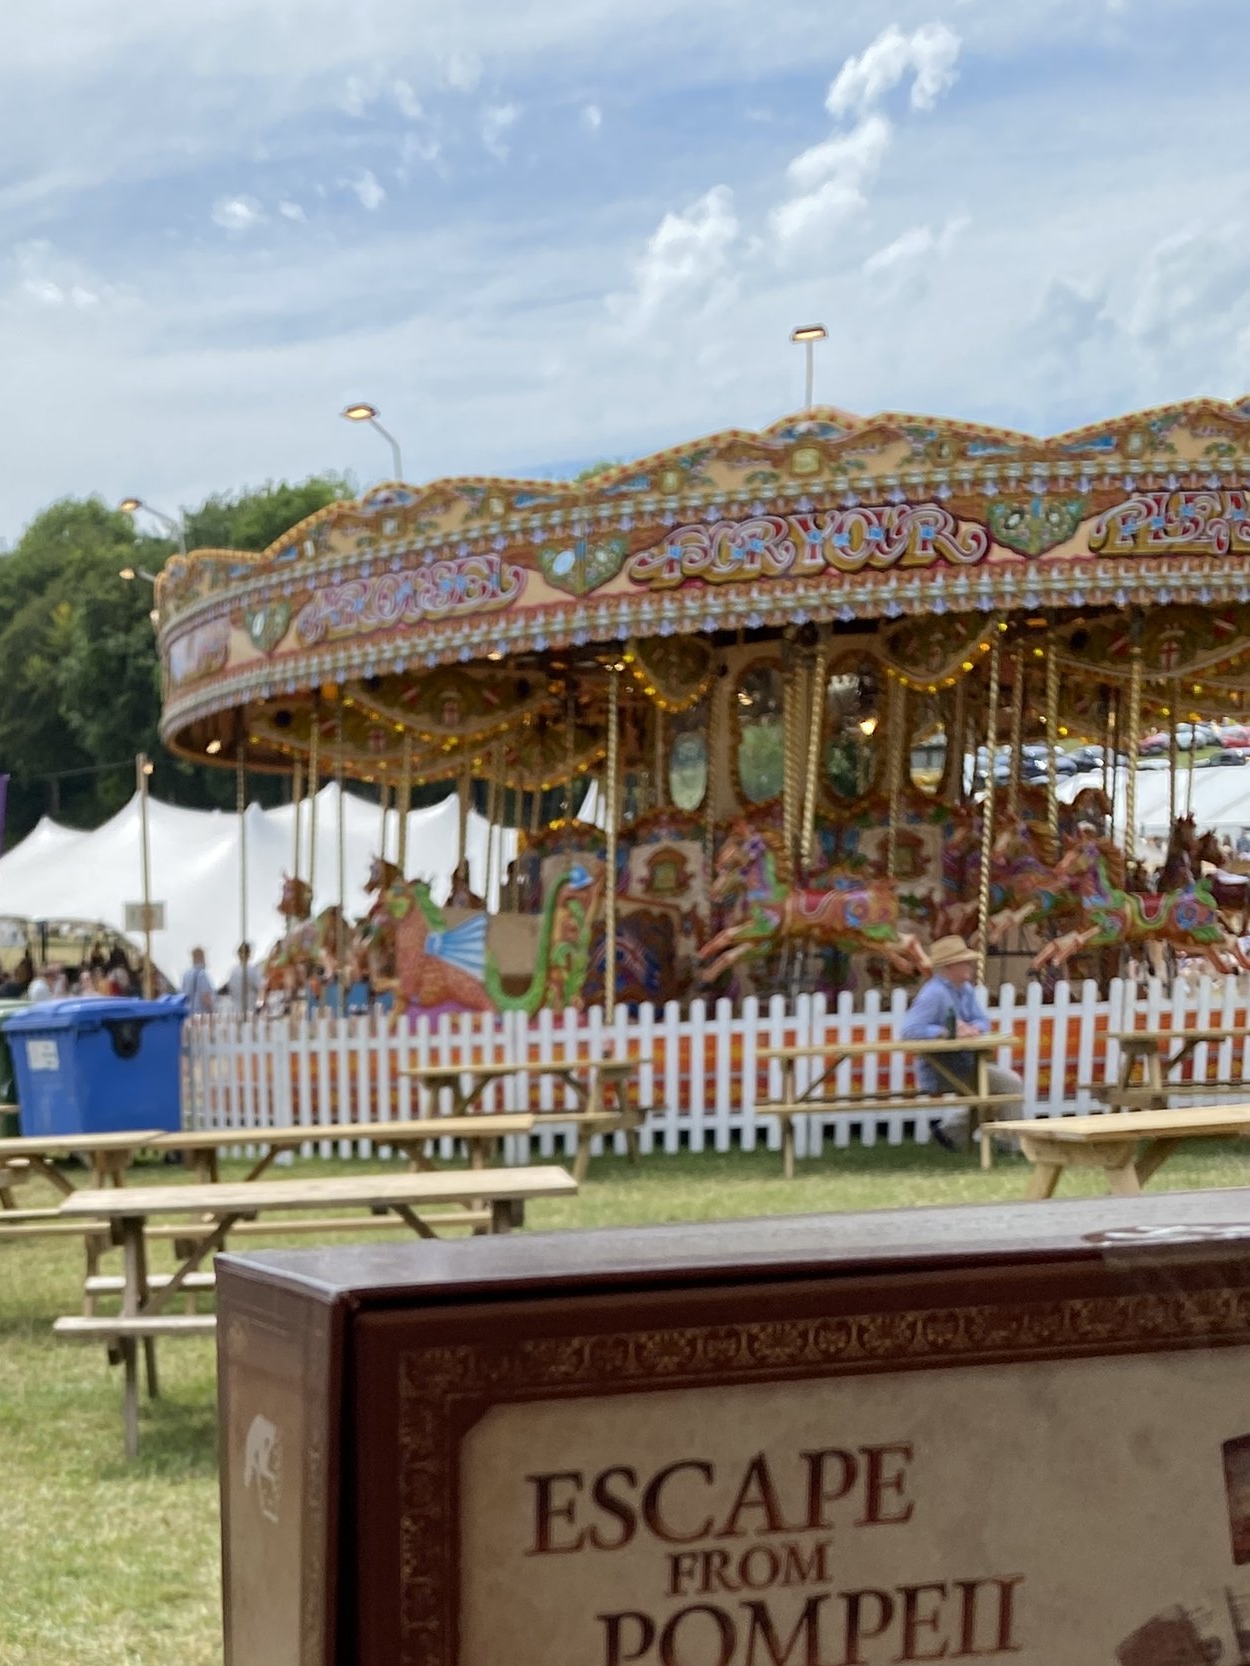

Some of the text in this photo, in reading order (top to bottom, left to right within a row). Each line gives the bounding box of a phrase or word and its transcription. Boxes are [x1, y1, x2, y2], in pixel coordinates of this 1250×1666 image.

[629, 502, 990, 583] FOR YOUR
[524, 1441, 915, 1557] ESCAPE
[666, 1541, 833, 1597] FROM
